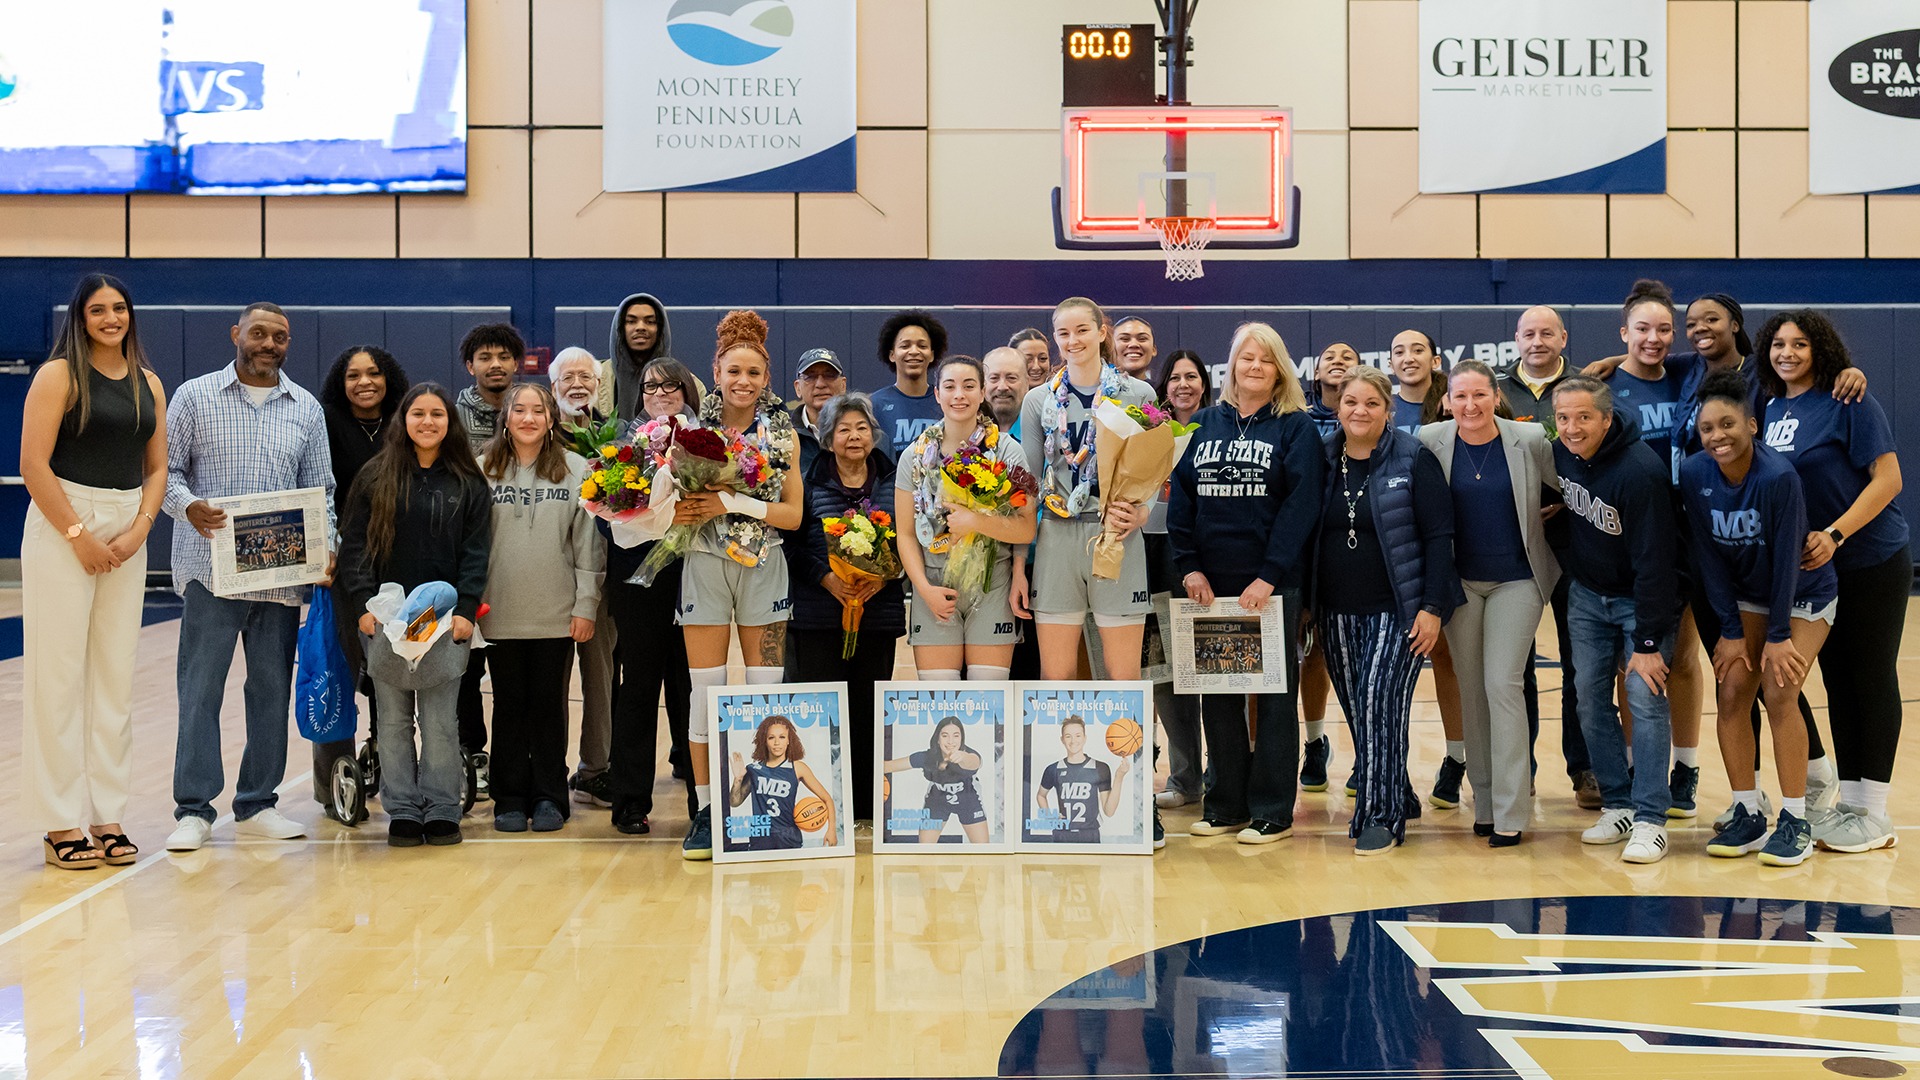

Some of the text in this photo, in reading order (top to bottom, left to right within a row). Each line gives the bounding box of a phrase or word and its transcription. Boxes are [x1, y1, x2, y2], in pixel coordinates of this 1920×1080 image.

[1070, 31, 1130, 58] 00.0
[1873, 48, 1903, 60] THE
[1432, 37, 1653, 77] GEISLER
[1850, 62, 1920, 84] BRA
[178, 70, 248, 112] VS
[656, 77, 802, 97] MONTEREY
[1483, 84, 1602, 97] MARKETING
[656, 106, 802, 125] PENINSULA
[656, 134, 801, 149] FOUNDATION
[1193, 440, 1274, 469] CAL STATE
[545, 488, 571, 501] MB
[1711, 508, 1762, 539] MB
[993, 622, 1014, 635] MB
[1229, 623, 1242, 632] BAY
[727, 703, 824, 717] WOMEN'S BASKETBALL
[893, 700, 989, 711] WOMEN'S BASKETBALL
[1032, 700, 1128, 711] WOMEN'S BASKETBALL
[756, 776, 792, 798] MB
[1061, 782, 1092, 800] MB
[766, 798, 781, 817] 3
[1063, 802, 1086, 823] 12
